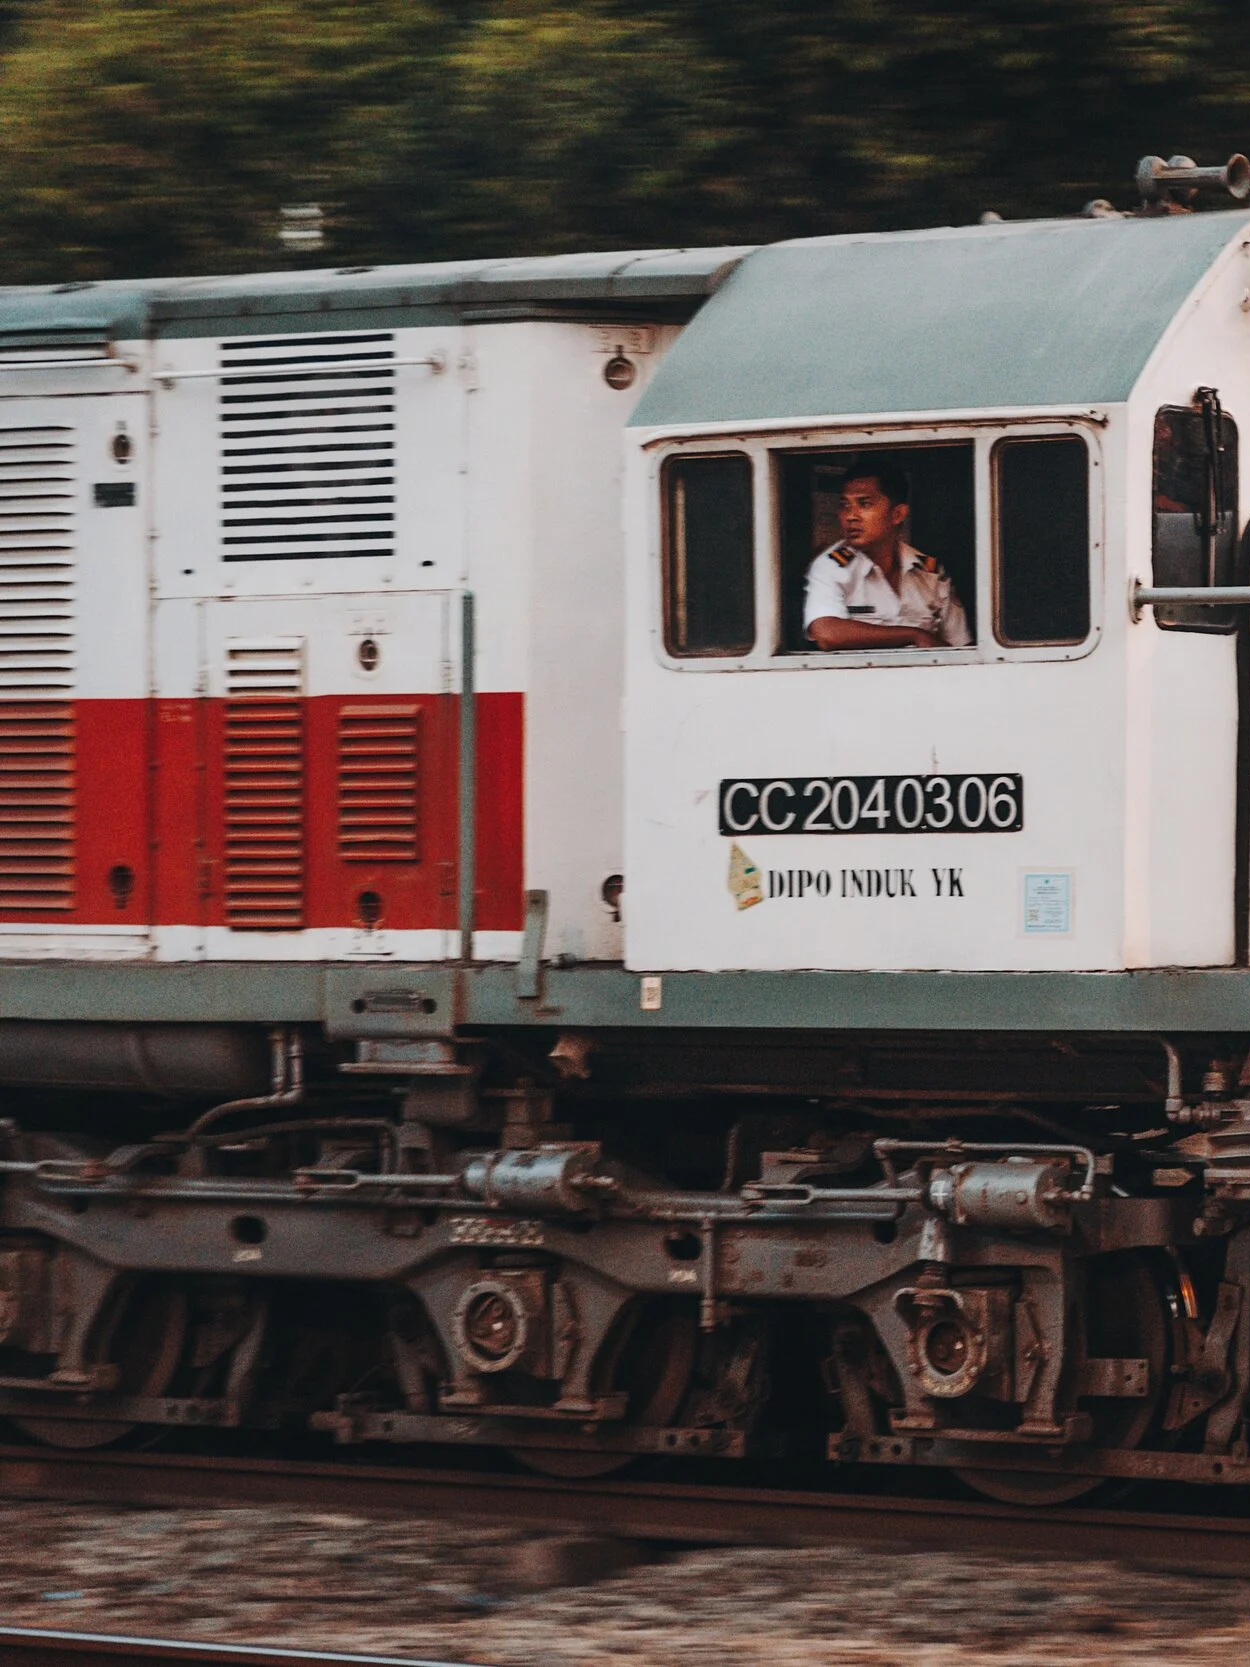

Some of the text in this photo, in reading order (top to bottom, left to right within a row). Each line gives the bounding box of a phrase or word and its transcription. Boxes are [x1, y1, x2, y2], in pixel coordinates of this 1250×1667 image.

[768, 867, 965, 899] DIPO INDUK YK
